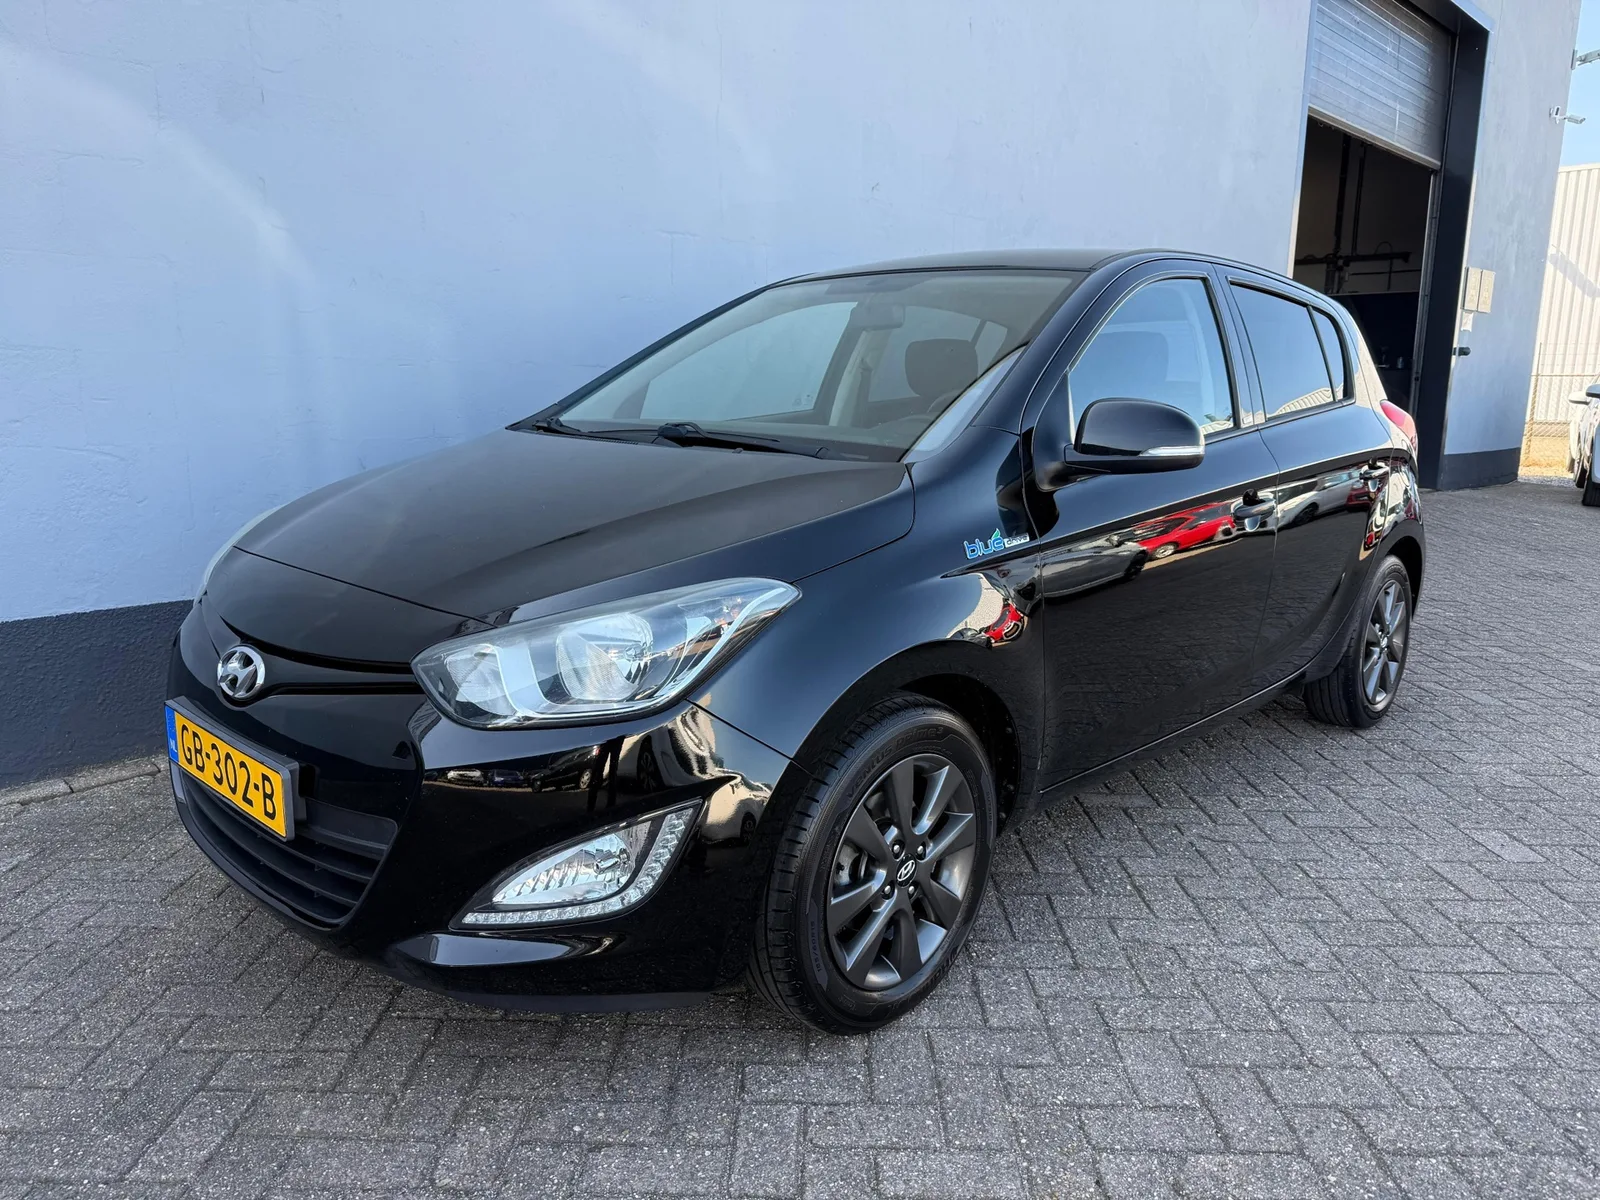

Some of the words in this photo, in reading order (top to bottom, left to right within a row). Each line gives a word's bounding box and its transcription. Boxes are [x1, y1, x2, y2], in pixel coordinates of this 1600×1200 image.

[963, 535, 1005, 559] blue
[169, 737, 178, 753] NL
[181, 724, 276, 821] GB-302-B
